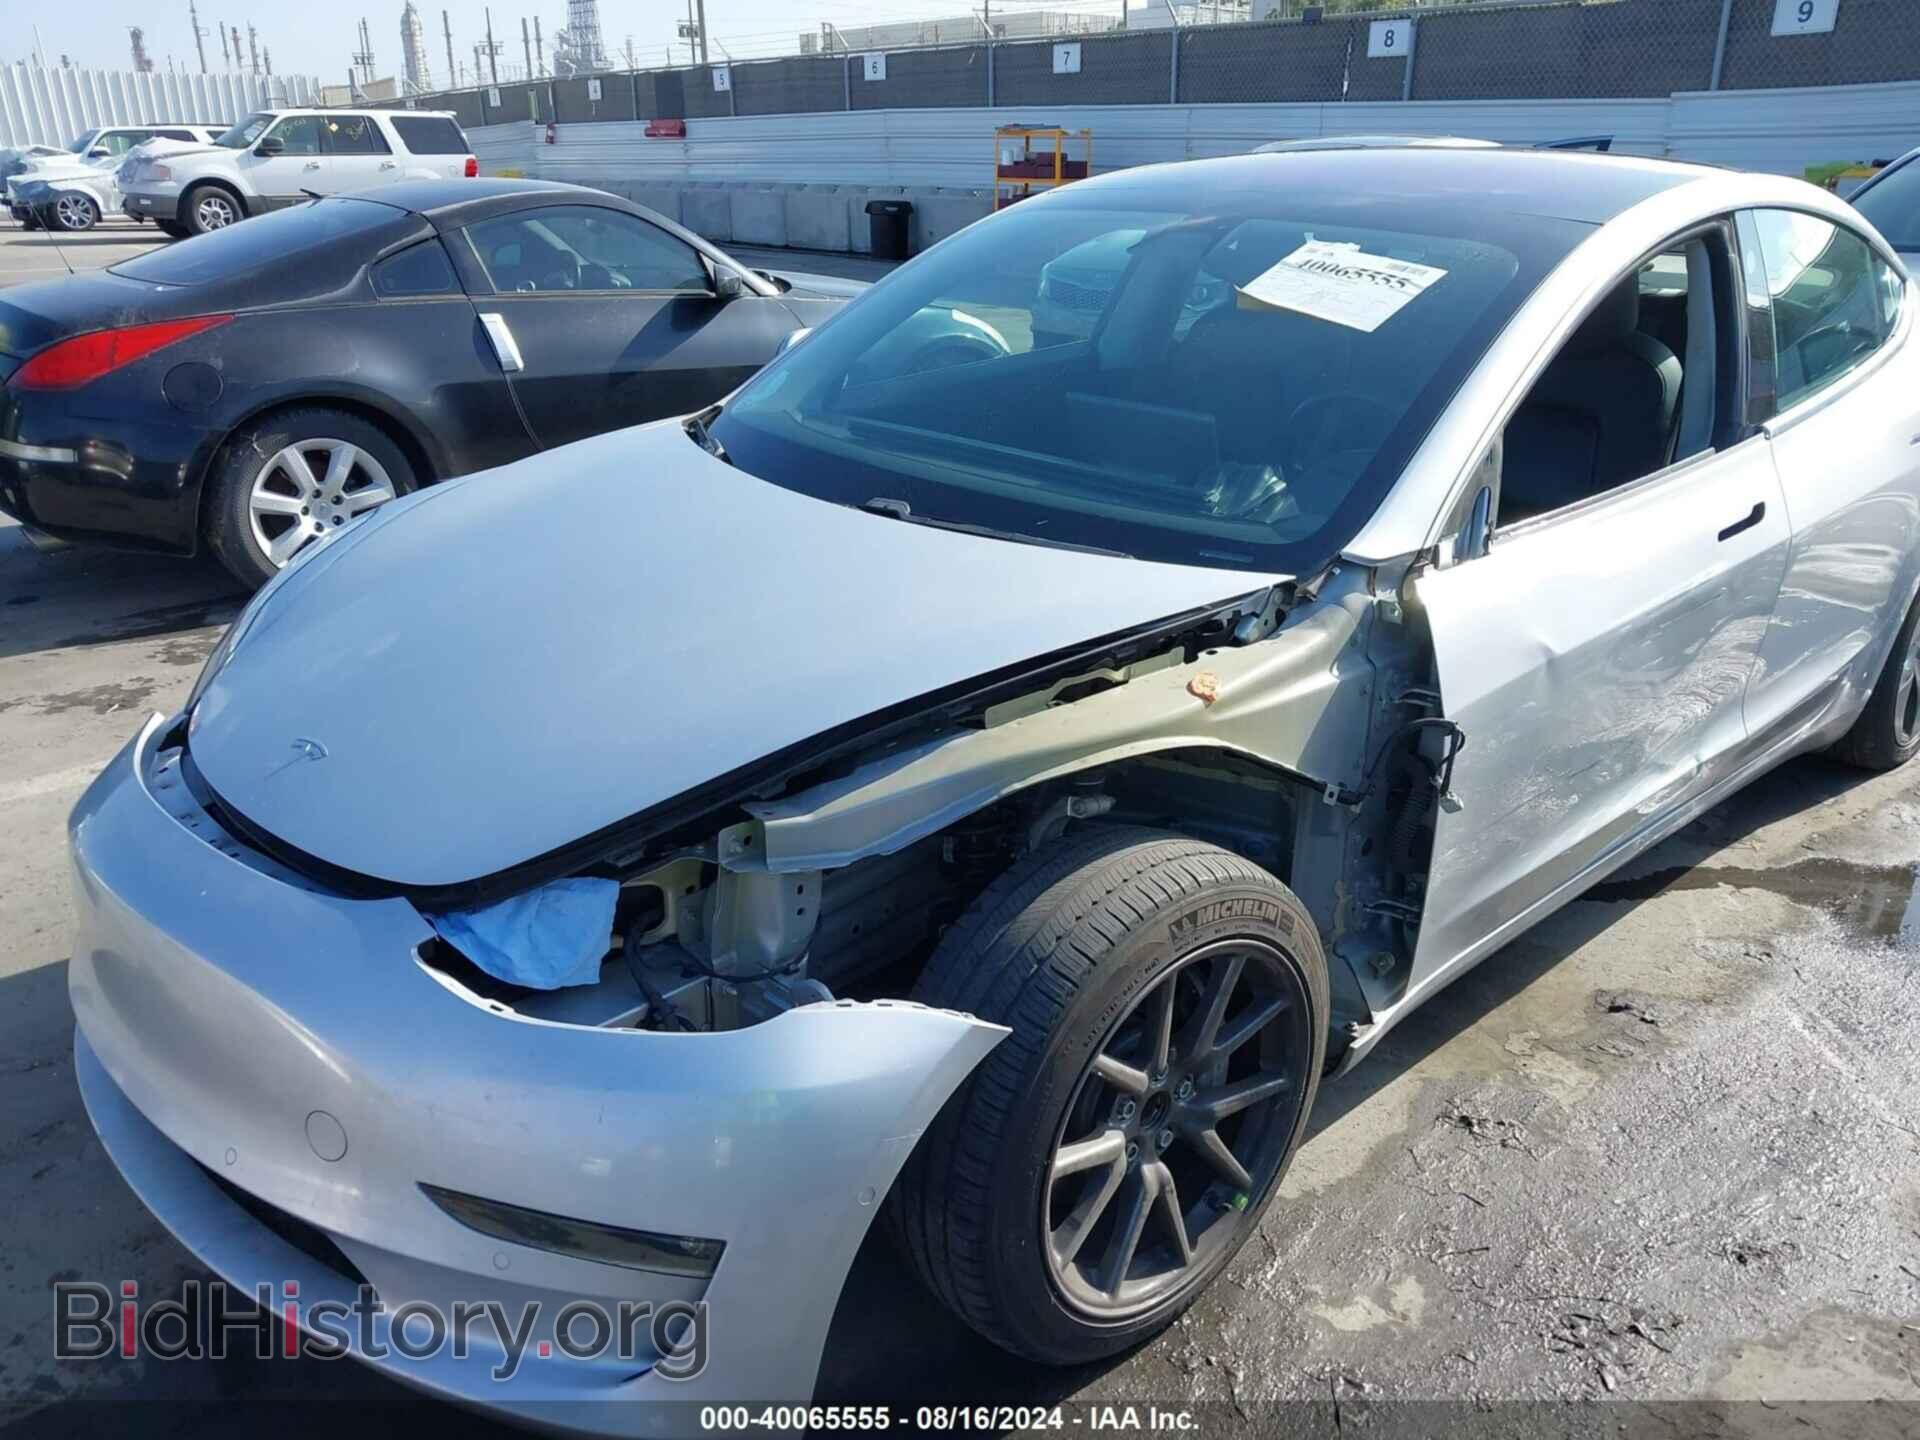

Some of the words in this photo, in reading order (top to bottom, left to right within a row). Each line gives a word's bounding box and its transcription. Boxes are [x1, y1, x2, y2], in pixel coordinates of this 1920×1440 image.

[1798, 0, 1814, 23] 9
[1384, 29, 1395, 48] 8
[1063, 51, 1071, 65] 7
[872, 61, 878, 75] 6
[1195, 898, 1280, 927] MICHELIN
